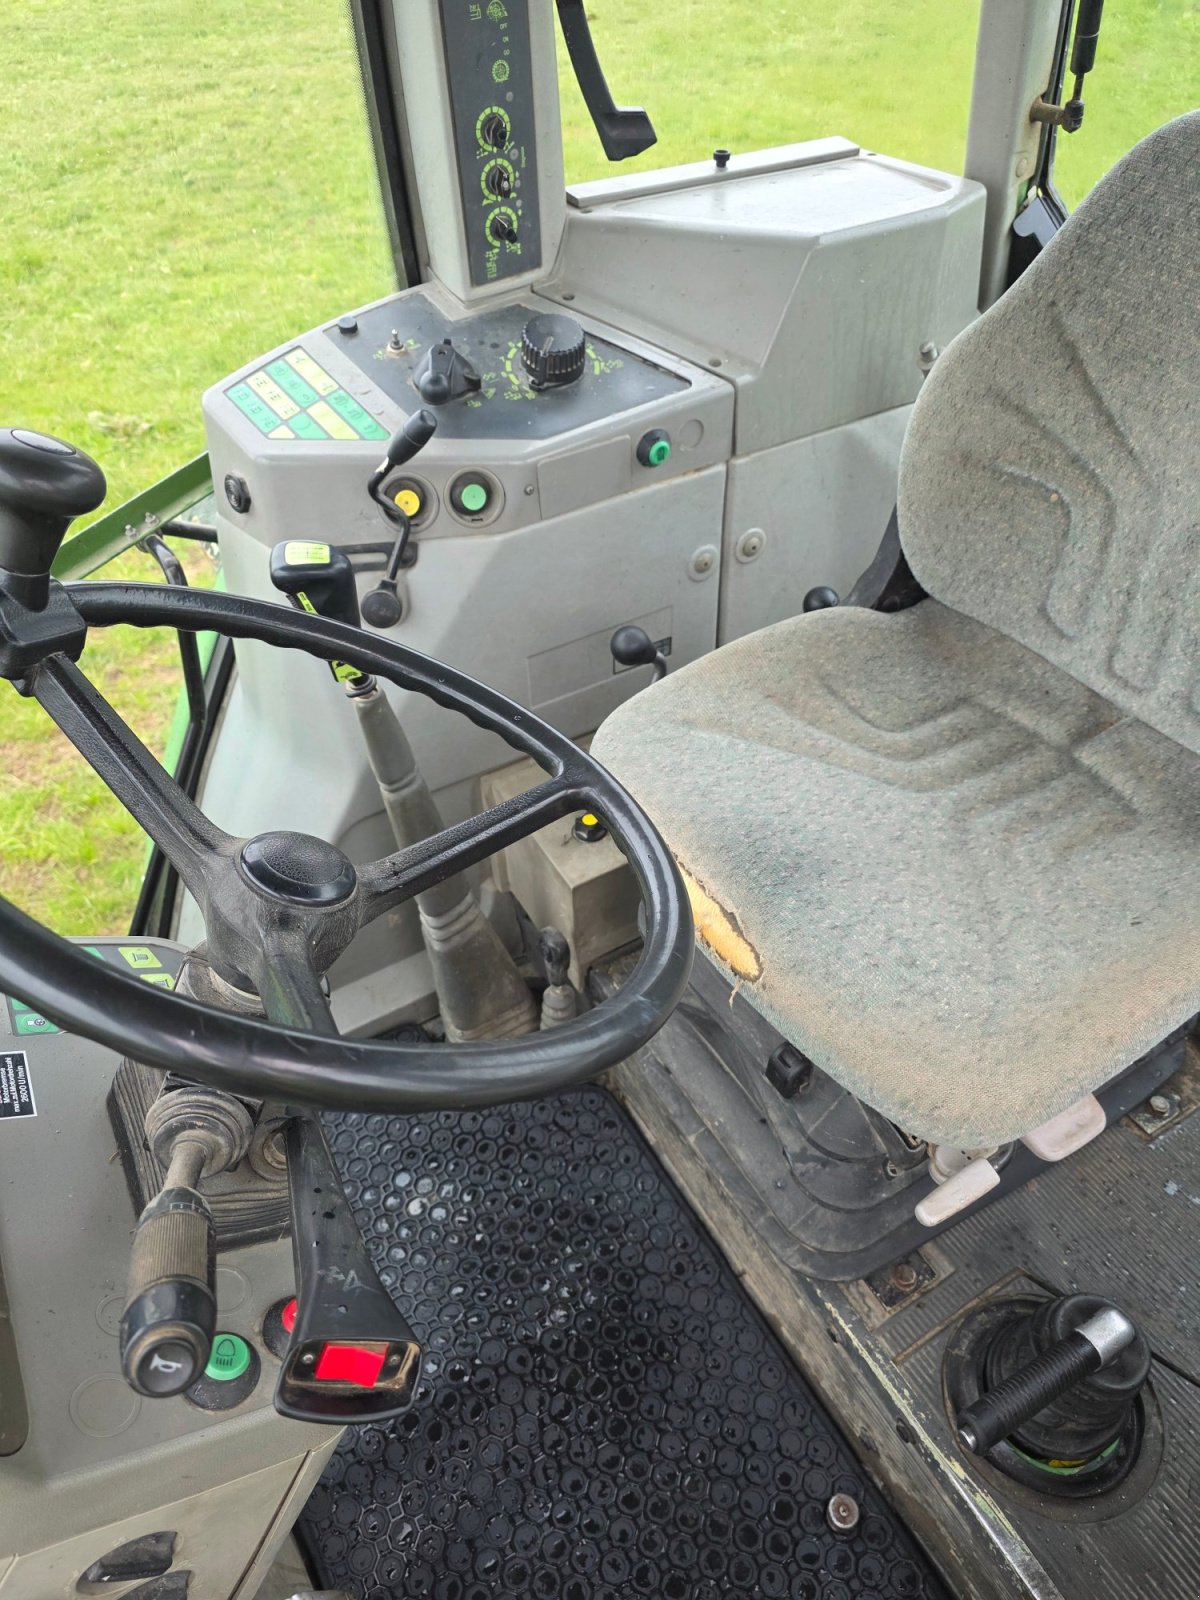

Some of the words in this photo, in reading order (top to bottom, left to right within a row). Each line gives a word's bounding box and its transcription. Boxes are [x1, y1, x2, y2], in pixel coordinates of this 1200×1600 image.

[16, 1065, 25, 1084] U/min
[1, 1068, 10, 1103] Motorbremse
[19, 1085, 29, 1102] 2600
